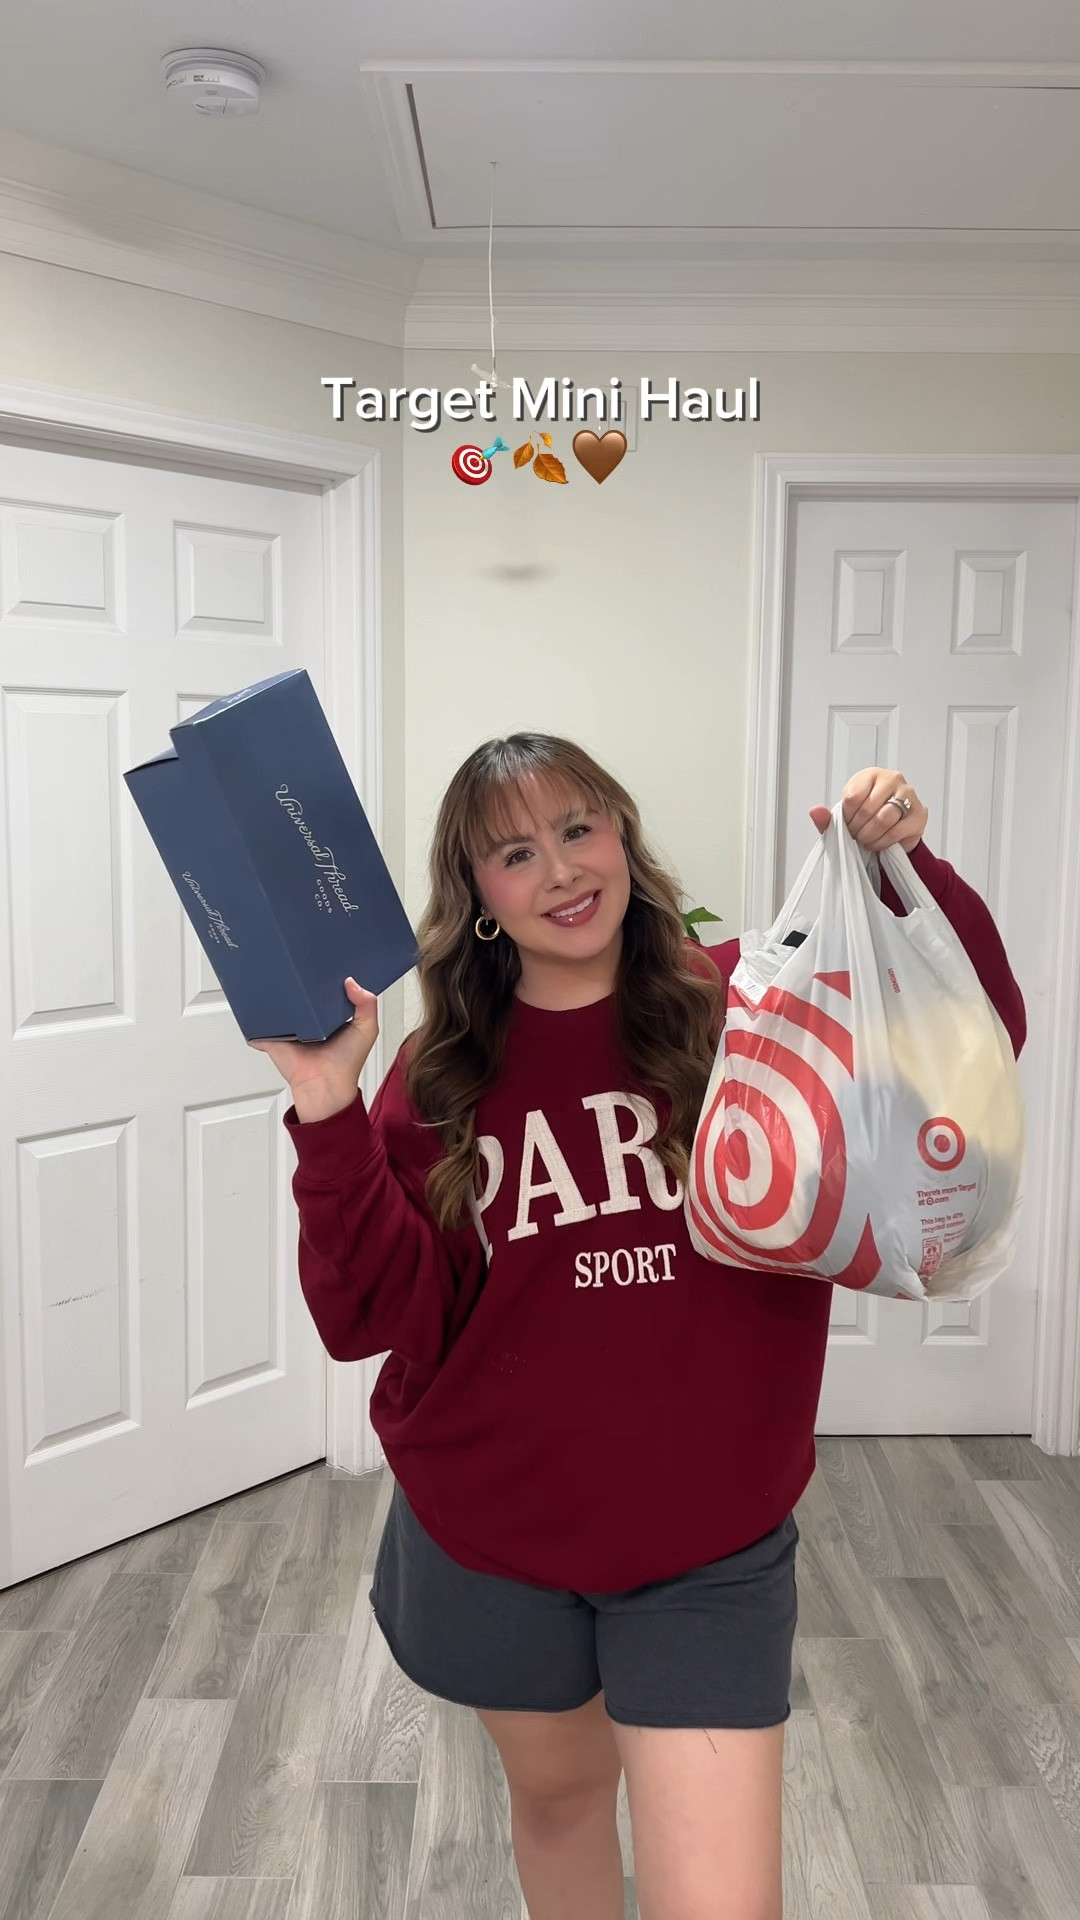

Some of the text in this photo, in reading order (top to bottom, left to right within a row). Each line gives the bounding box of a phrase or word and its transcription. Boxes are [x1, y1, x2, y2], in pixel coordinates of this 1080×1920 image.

[275, 783, 360, 917] Universal Thread
[917, 1183, 976, 1198] There's more Target
[574, 1243, 677, 1289] SPORT
